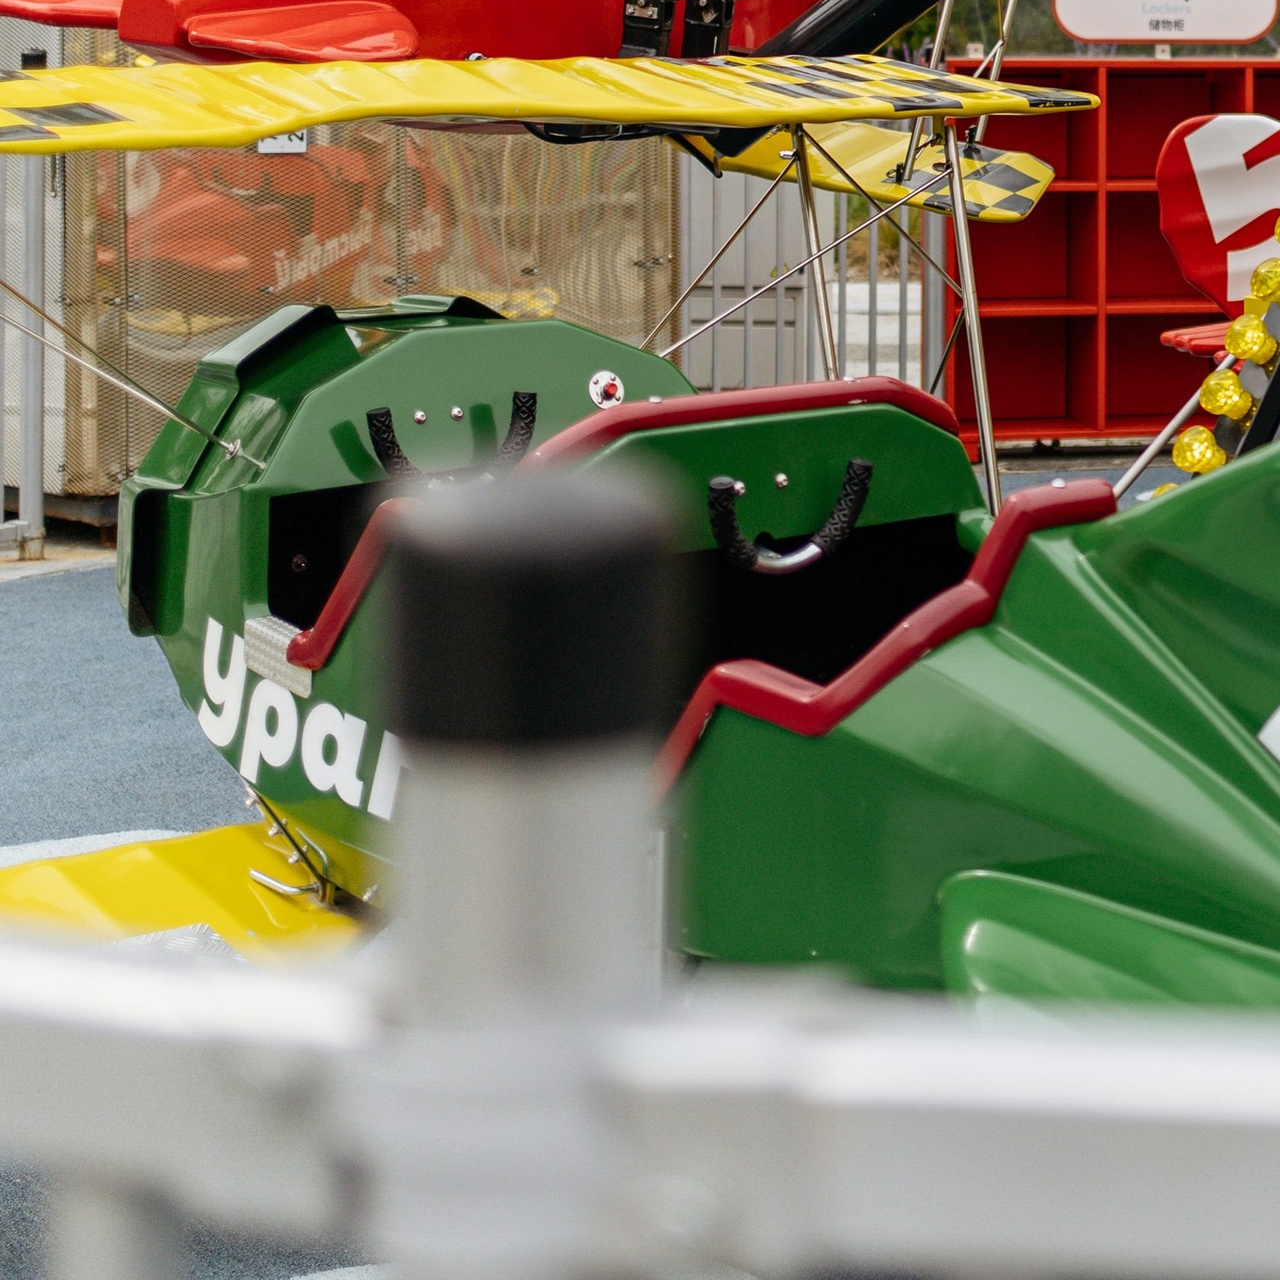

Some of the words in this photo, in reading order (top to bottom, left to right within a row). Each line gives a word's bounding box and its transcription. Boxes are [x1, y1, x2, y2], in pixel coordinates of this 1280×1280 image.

[1142, 3, 1191, 14] Lockers
[1149, 20, 1185, 32] 储物柜
